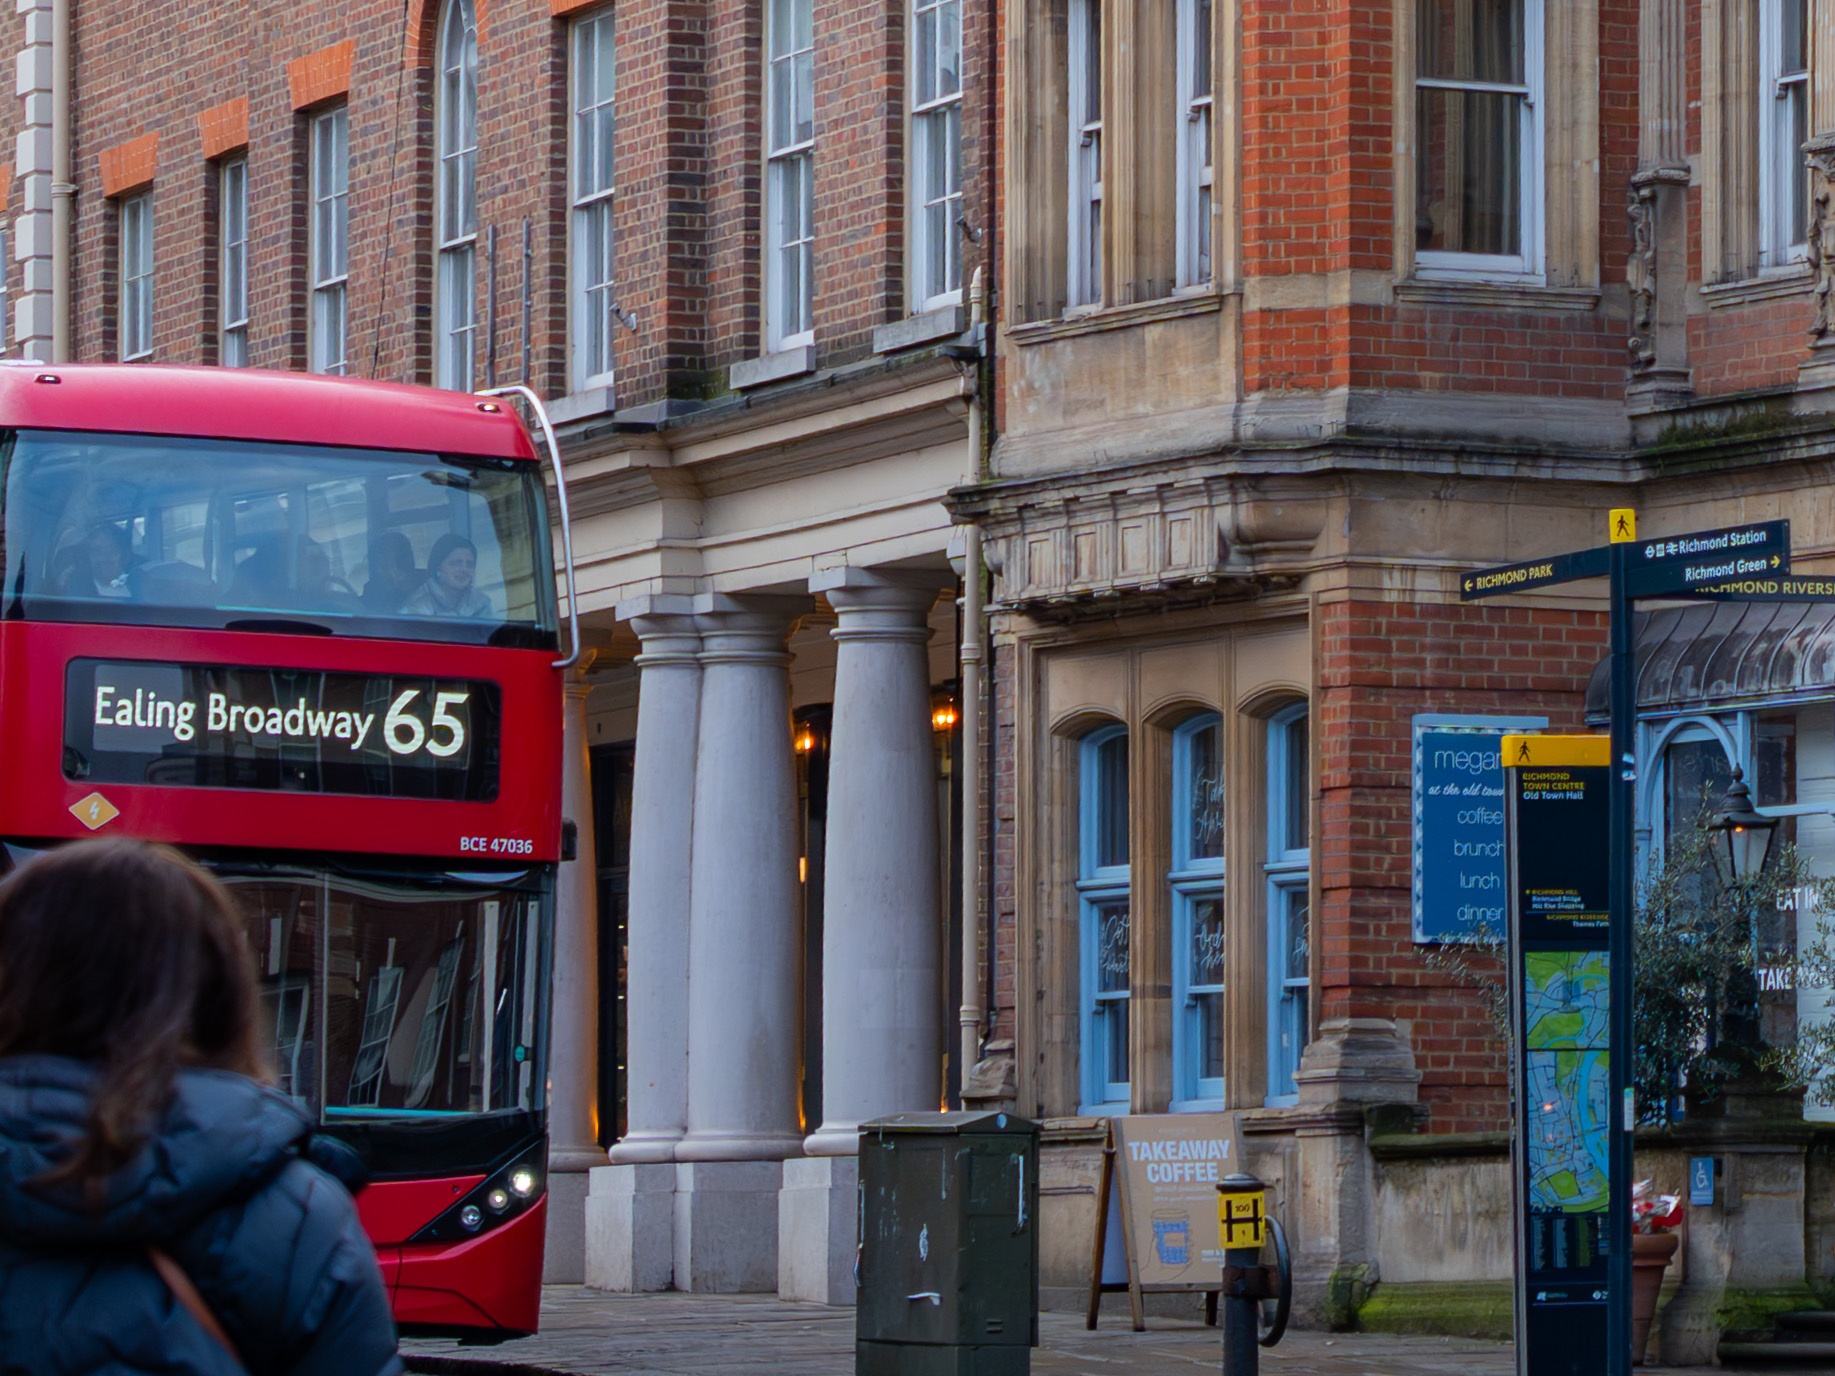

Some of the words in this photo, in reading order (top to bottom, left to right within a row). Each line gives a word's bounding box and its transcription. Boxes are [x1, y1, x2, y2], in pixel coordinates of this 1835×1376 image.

[1678, 533, 1728, 555] Richmond
[1730, 529, 1767, 548] Station
[1475, 567, 1527, 590] RICHMOND
[1528, 563, 1554, 583] PARK
[1684, 561, 1735, 583] Richmond
[1736, 556, 1768, 575] Green
[95, 685, 196, 742] Ealing
[207, 691, 375, 750] Broadway
[383, 689, 470, 758] 65
[1428, 785, 1441, 796] at
[1443, 782, 1460, 796] the
[1462, 782, 1482, 796] old
[1523, 782, 1550, 790] TOWN
[1552, 782, 1585, 790] CENTRE
[1523, 791, 1539, 800] Old
[1541, 791, 1565, 800] Town
[1566, 791, 1584, 800] Hall
[1457, 806, 1503, 825] coffee
[460, 836, 488, 852] BCE
[490, 838, 533, 854] 47036
[1453, 838, 1505, 857] brunch
[1460, 870, 1500, 890] lunch
[1776, 888, 1801, 911] EAT
[1804, 886, 1819, 909] IN
[1457, 904, 1504, 921] dinner
[1758, 967, 1792, 991] TAKE
[1128, 1139, 1230, 1162] TAKEAWAY
[1145, 1162, 1219, 1184] COFFEE
